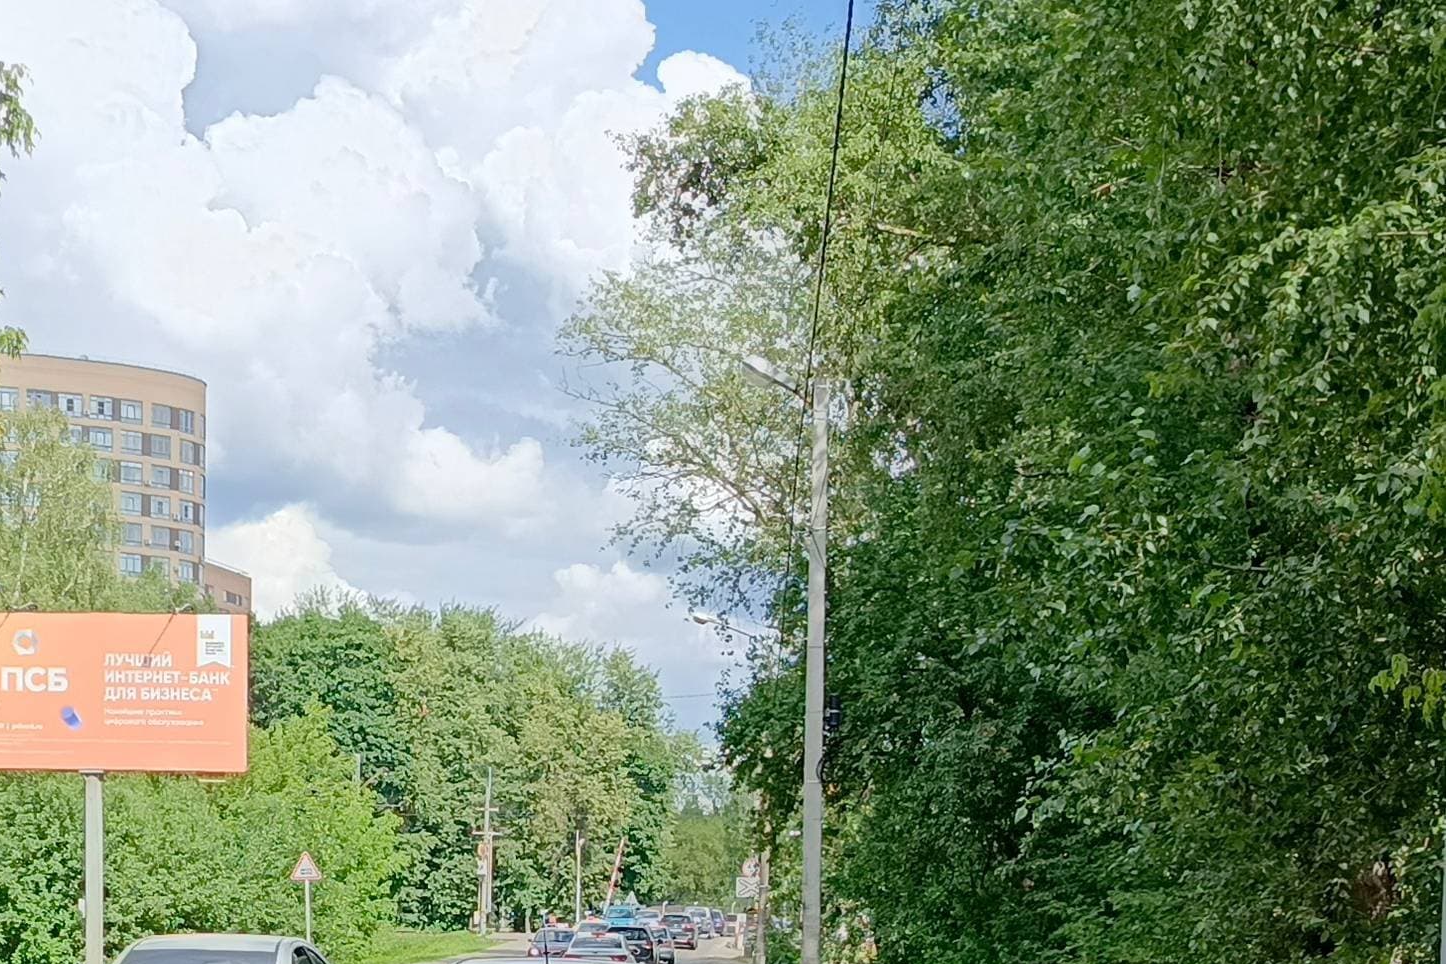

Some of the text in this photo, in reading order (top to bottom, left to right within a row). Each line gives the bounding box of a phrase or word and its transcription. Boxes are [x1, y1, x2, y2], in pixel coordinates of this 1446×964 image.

[0, 666, 69, 693] ПСБ
[104, 669, 231, 686] ИНТЕРНЕТ-БАНК
[104, 686, 213, 702] ДЛЯ БИЗНЕСА
